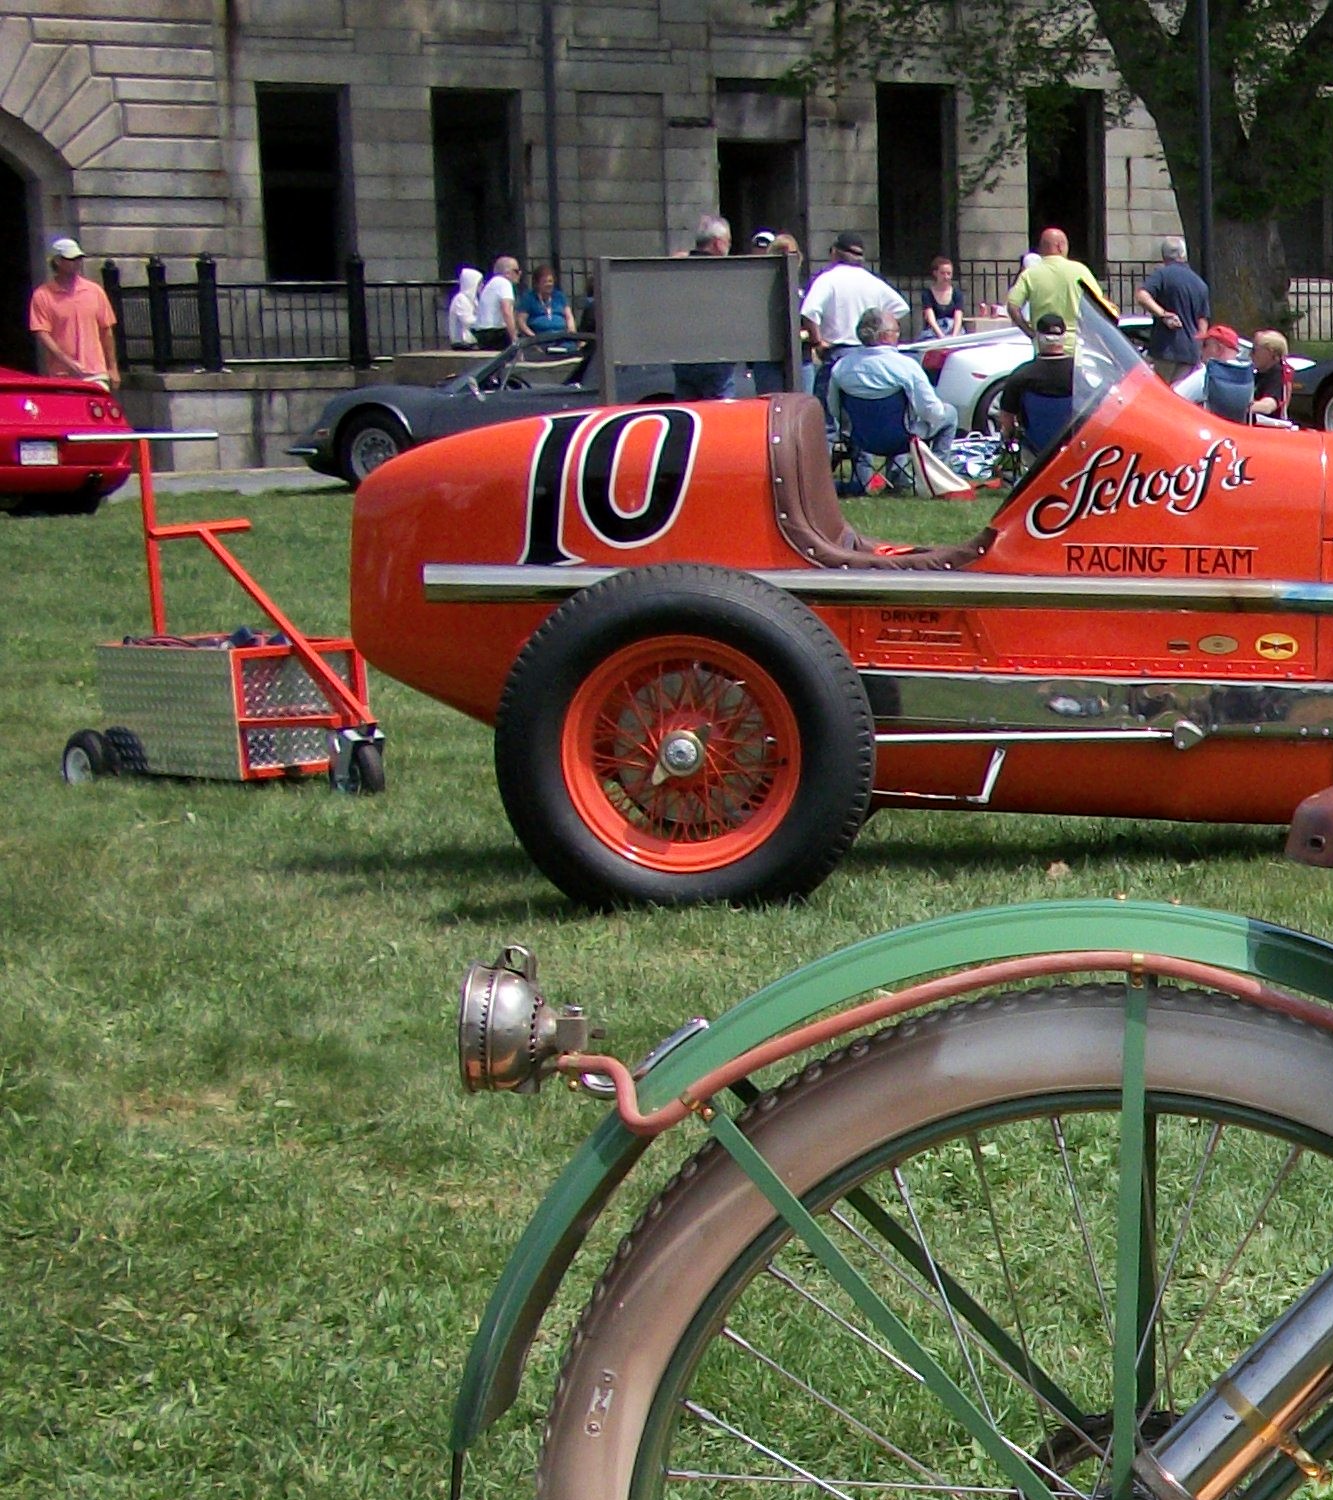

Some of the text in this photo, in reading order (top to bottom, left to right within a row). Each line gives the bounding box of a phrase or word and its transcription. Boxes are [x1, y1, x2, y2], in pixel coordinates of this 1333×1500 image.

[517, 406, 702, 567] 10
[1025, 438, 1255, 539] Schoof's
[1066, 545, 1255, 575] RACING TEAM
[880, 609, 940, 624] DRIVER
